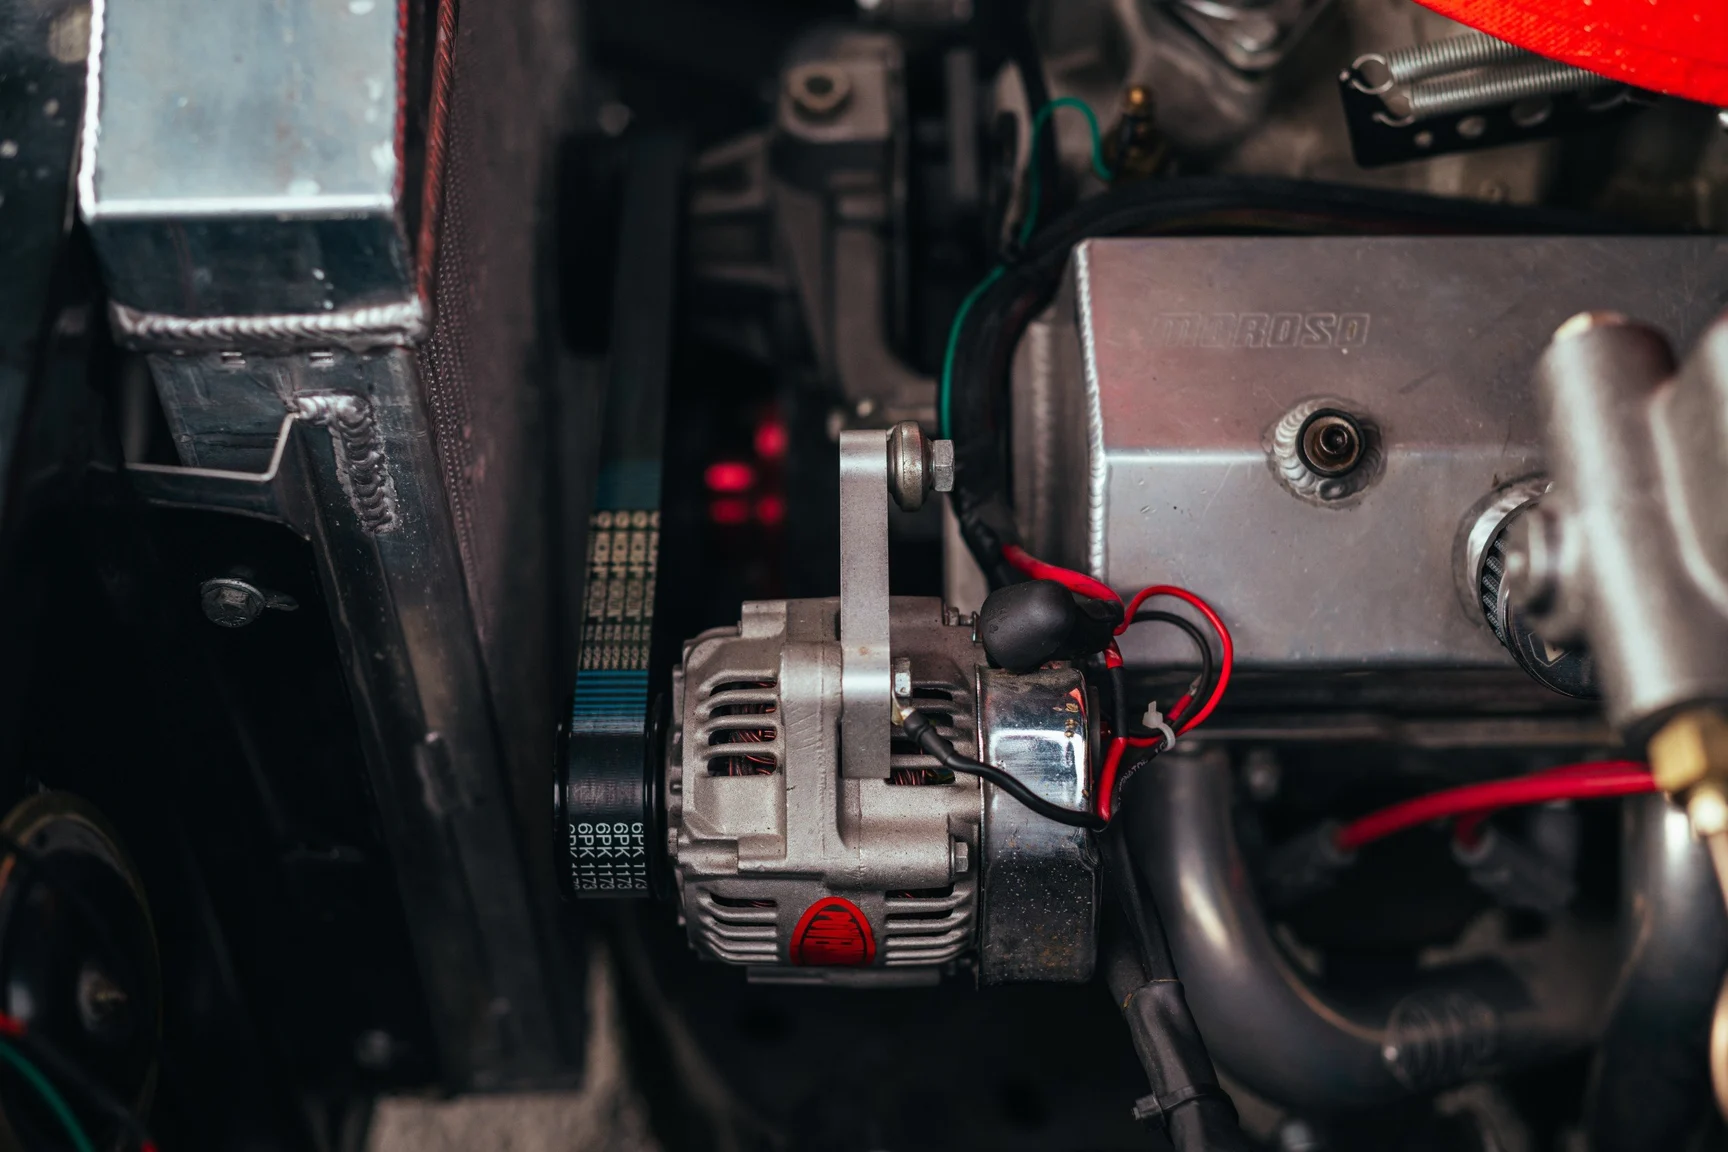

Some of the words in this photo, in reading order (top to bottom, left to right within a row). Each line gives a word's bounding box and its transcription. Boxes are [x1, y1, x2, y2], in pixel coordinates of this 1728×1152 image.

[1152, 311, 1371, 349] MOROSO
[578, 822, 595, 858] 6PK
[595, 822, 613, 858] 6PK
[613, 822, 631, 858] 6PK
[580, 862, 598, 890] 1173
[597, 862, 615, 890] 1173
[615, 862, 633, 890] 1173
